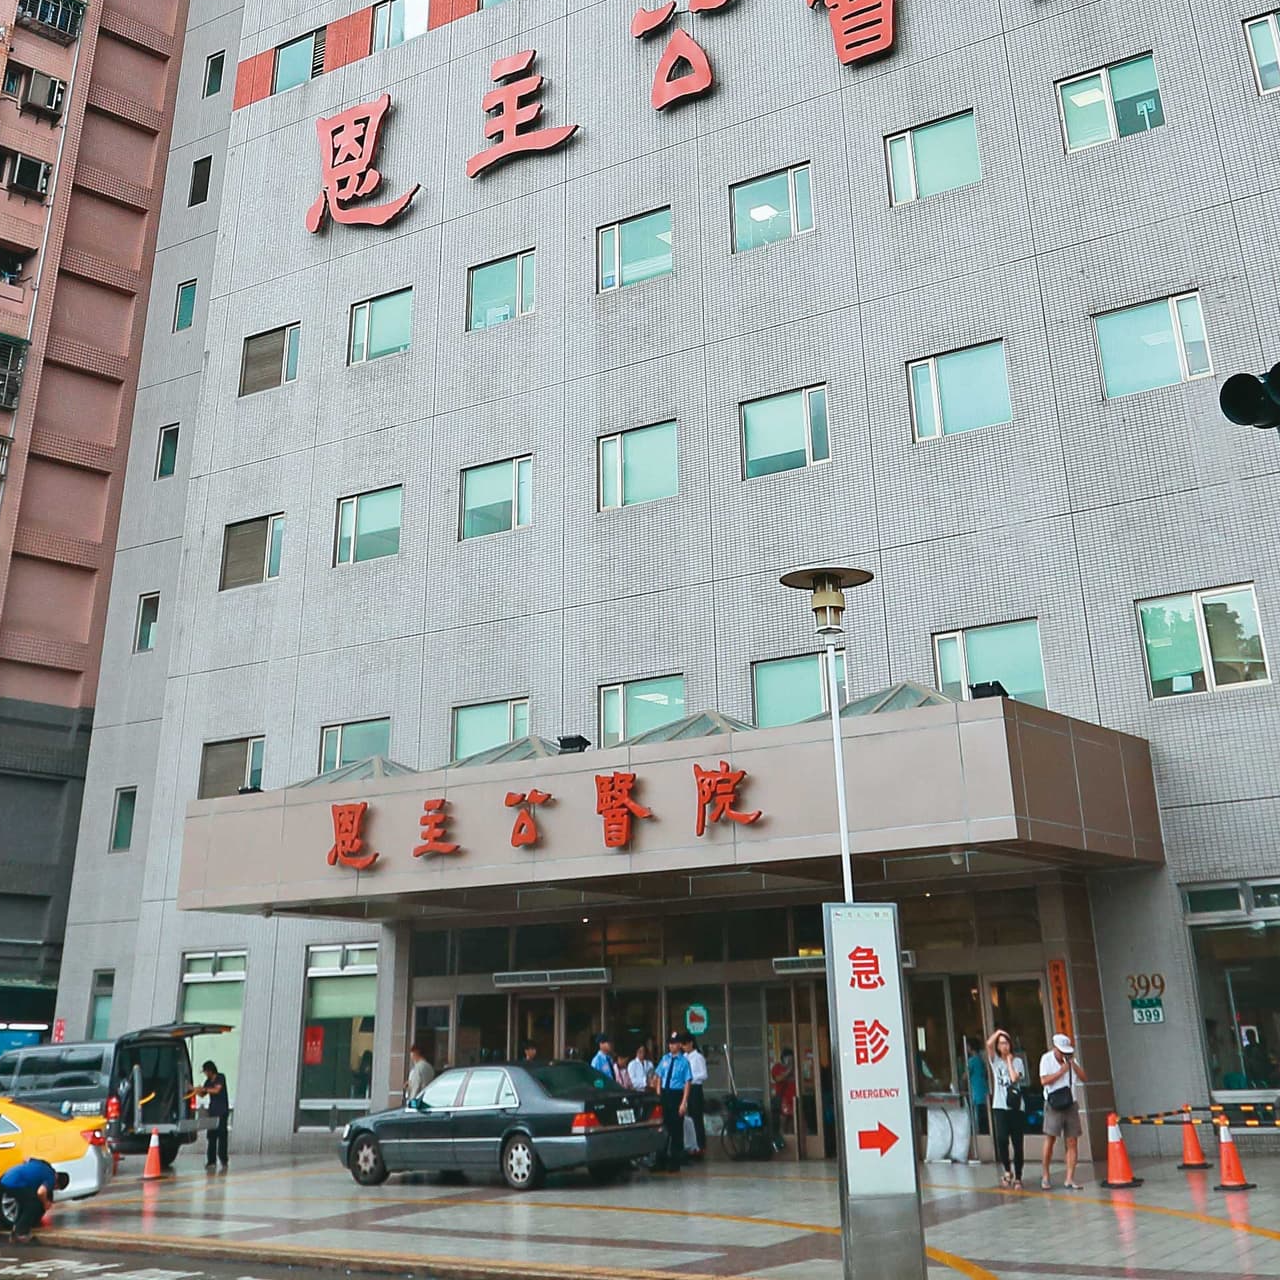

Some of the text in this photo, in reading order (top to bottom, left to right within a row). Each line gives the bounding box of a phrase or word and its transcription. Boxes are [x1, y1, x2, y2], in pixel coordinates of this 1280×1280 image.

[327, 761, 762, 869] 恩主公醫院
[1127, 974, 1165, 999] 399
[848, 946, 889, 1065] 急診
[1138, 1009, 1160, 1021] 399
[850, 1088, 899, 1100] EMERGENCY
